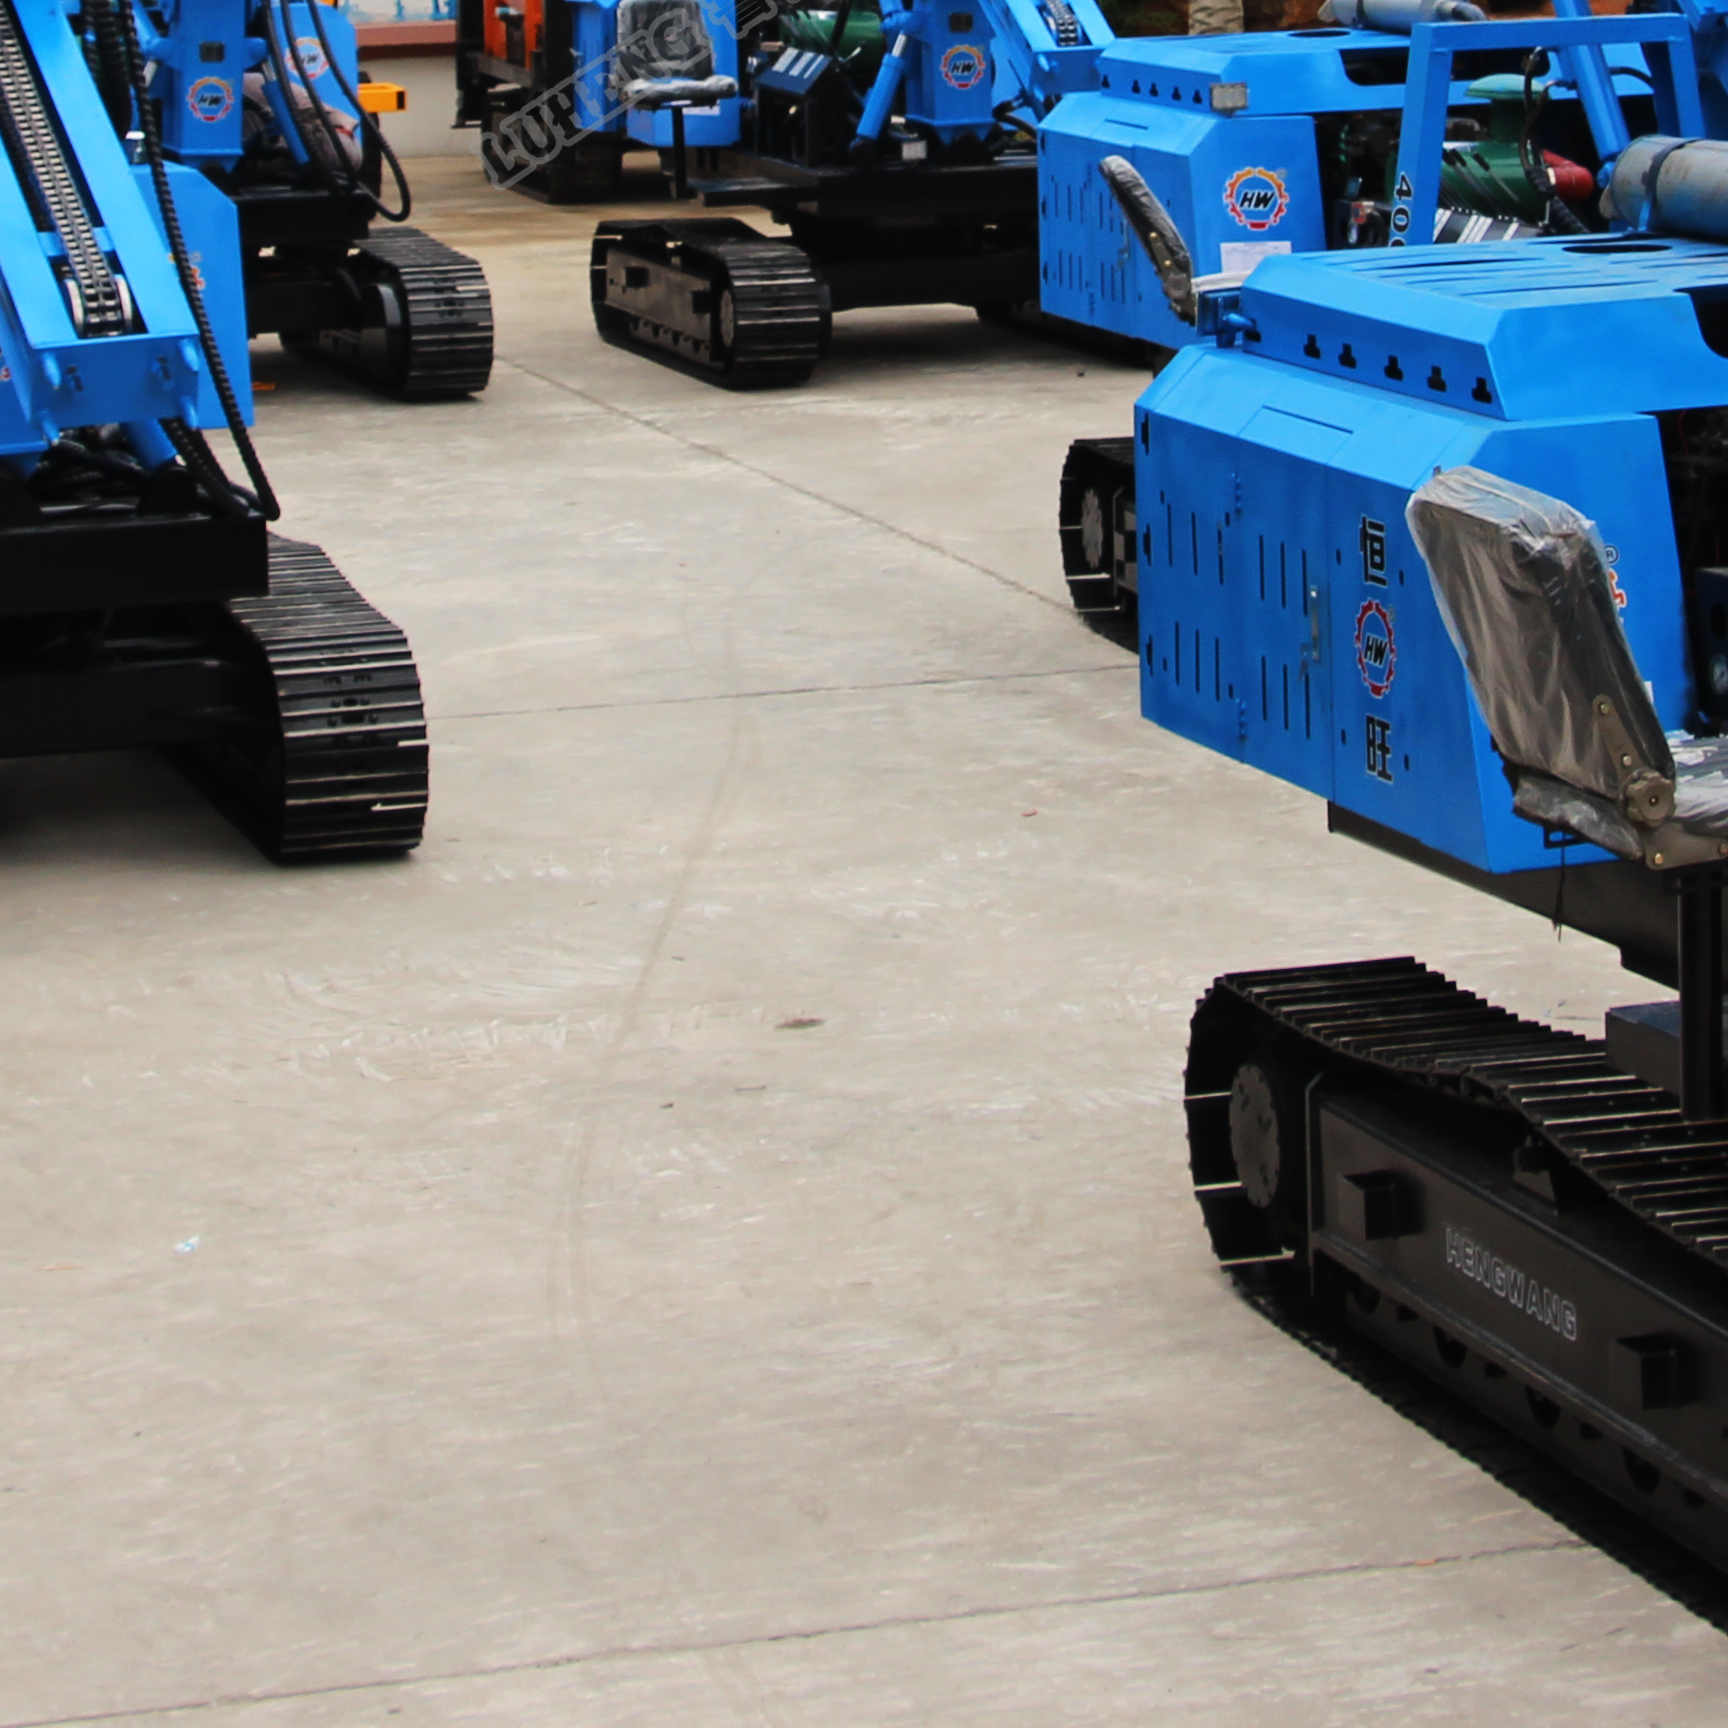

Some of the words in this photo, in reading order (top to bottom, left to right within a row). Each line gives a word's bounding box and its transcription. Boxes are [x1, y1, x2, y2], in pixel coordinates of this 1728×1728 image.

[1239, 191, 1276, 210] HW
[1364, 633, 1387, 668] HW
[1446, 1227, 1577, 1341] HENGWANG
